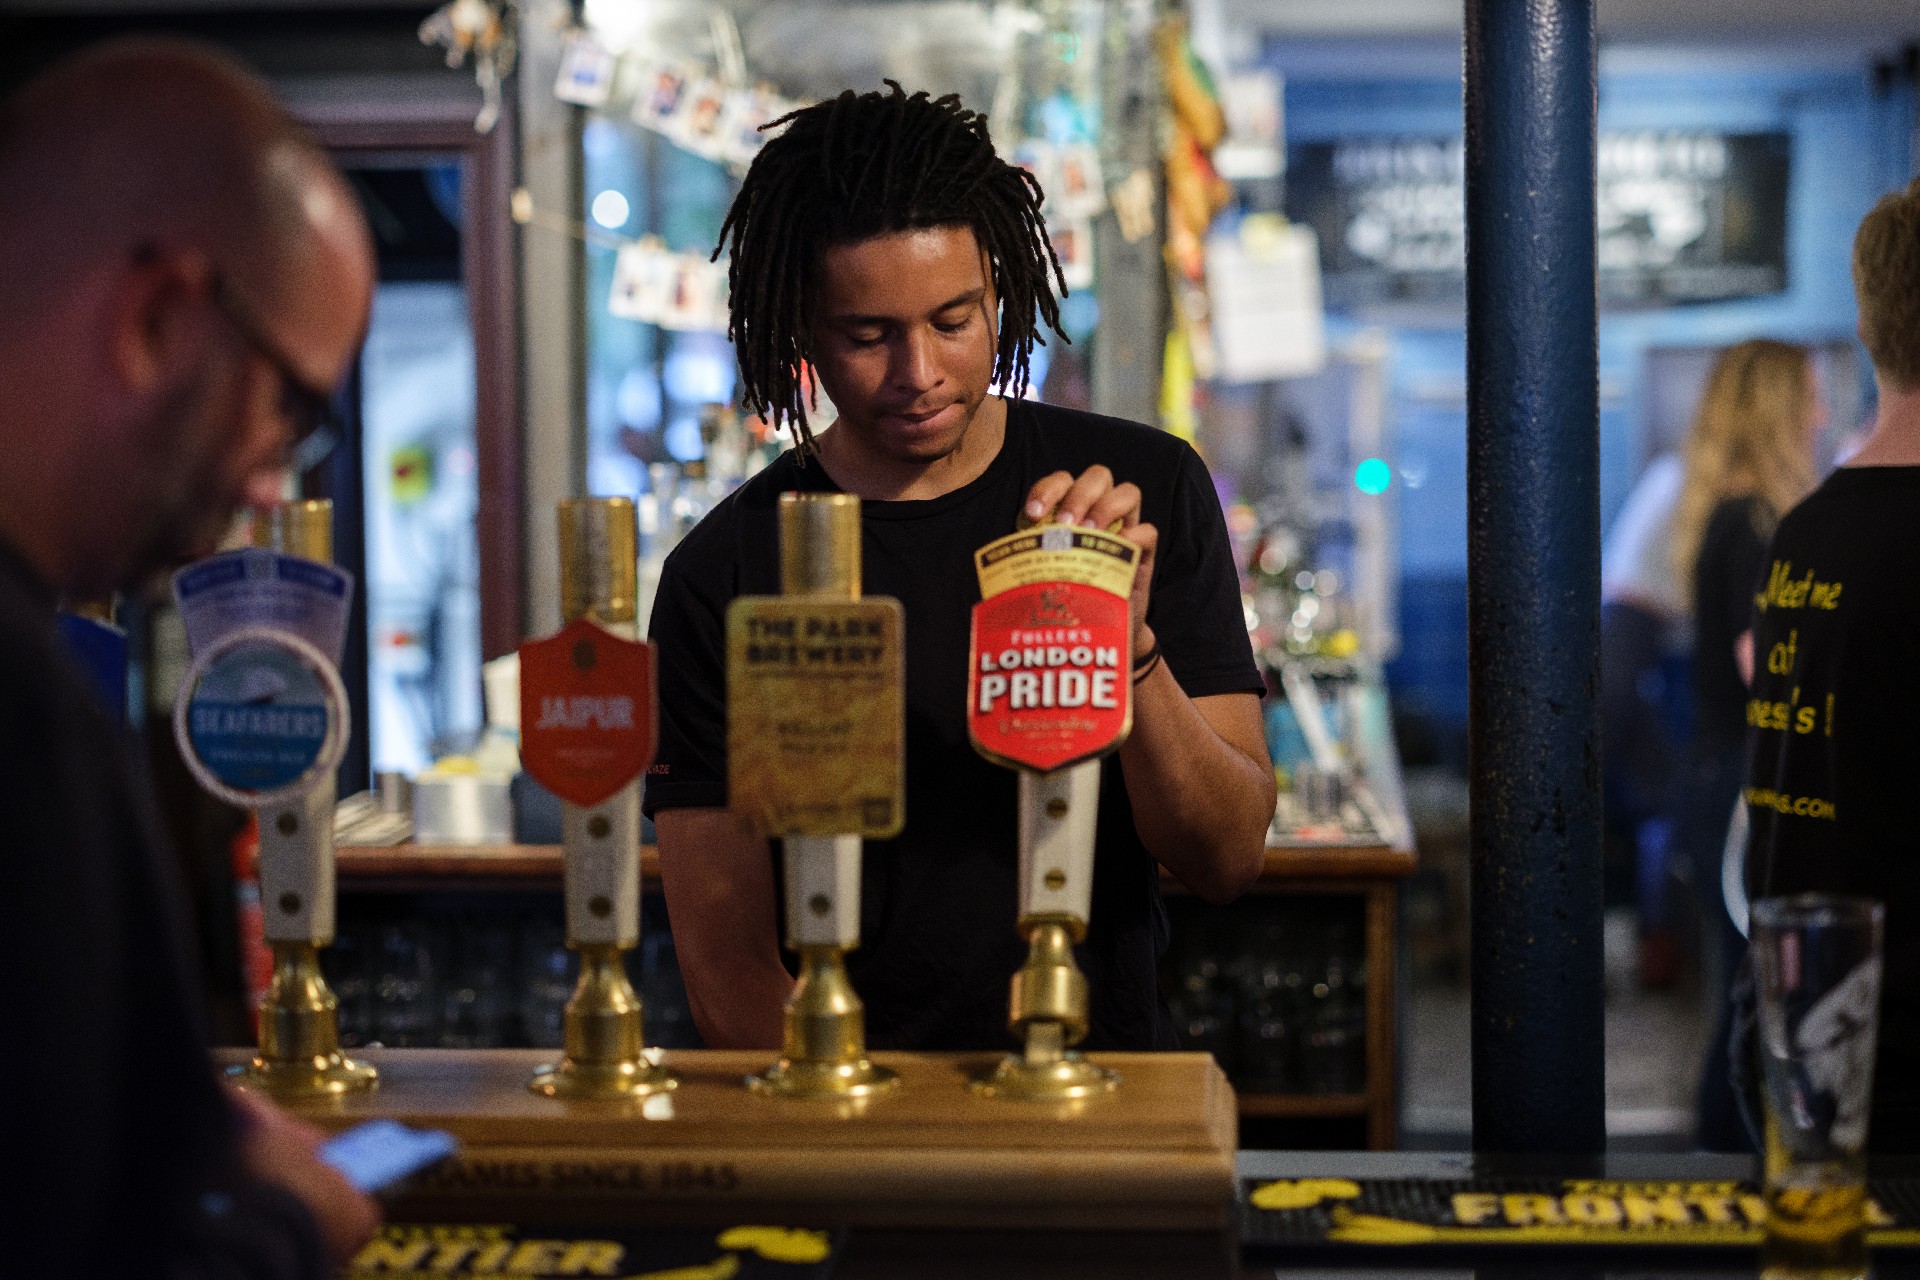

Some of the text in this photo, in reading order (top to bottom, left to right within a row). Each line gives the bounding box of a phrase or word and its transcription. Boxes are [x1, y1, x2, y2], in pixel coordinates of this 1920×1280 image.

[746, 616, 795, 638] THE
[1010, 629, 1092, 645] FULLER'S
[980, 646, 1118, 672] LONDON
[979, 669, 1118, 712] PRIDE
[535, 695, 635, 731] JAIPUR
